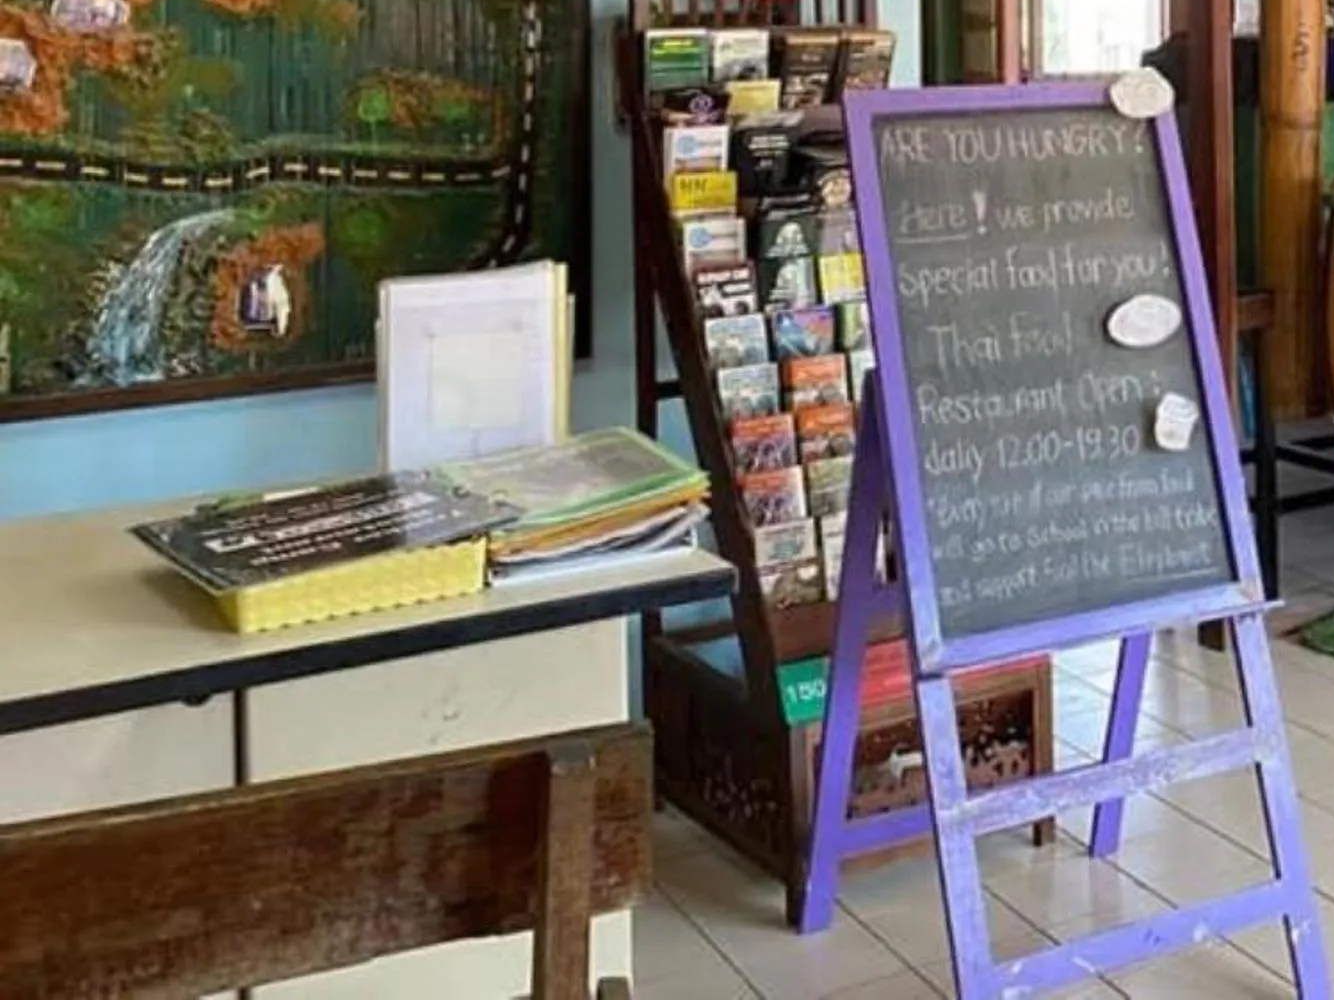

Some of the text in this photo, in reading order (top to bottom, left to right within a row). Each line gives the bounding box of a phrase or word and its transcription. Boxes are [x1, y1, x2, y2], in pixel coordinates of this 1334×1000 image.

[880, 126, 929, 164] ARE
[946, 124, 999, 165] YOU
[997, 205, 1035, 231] we
[1040, 188, 1135, 232] provide
[898, 258, 999, 309] Special
[1062, 243, 1105, 286] for
[926, 322, 1000, 371] Thai
[916, 379, 1067, 426] Restaurant
[924, 438, 984, 485] daily
